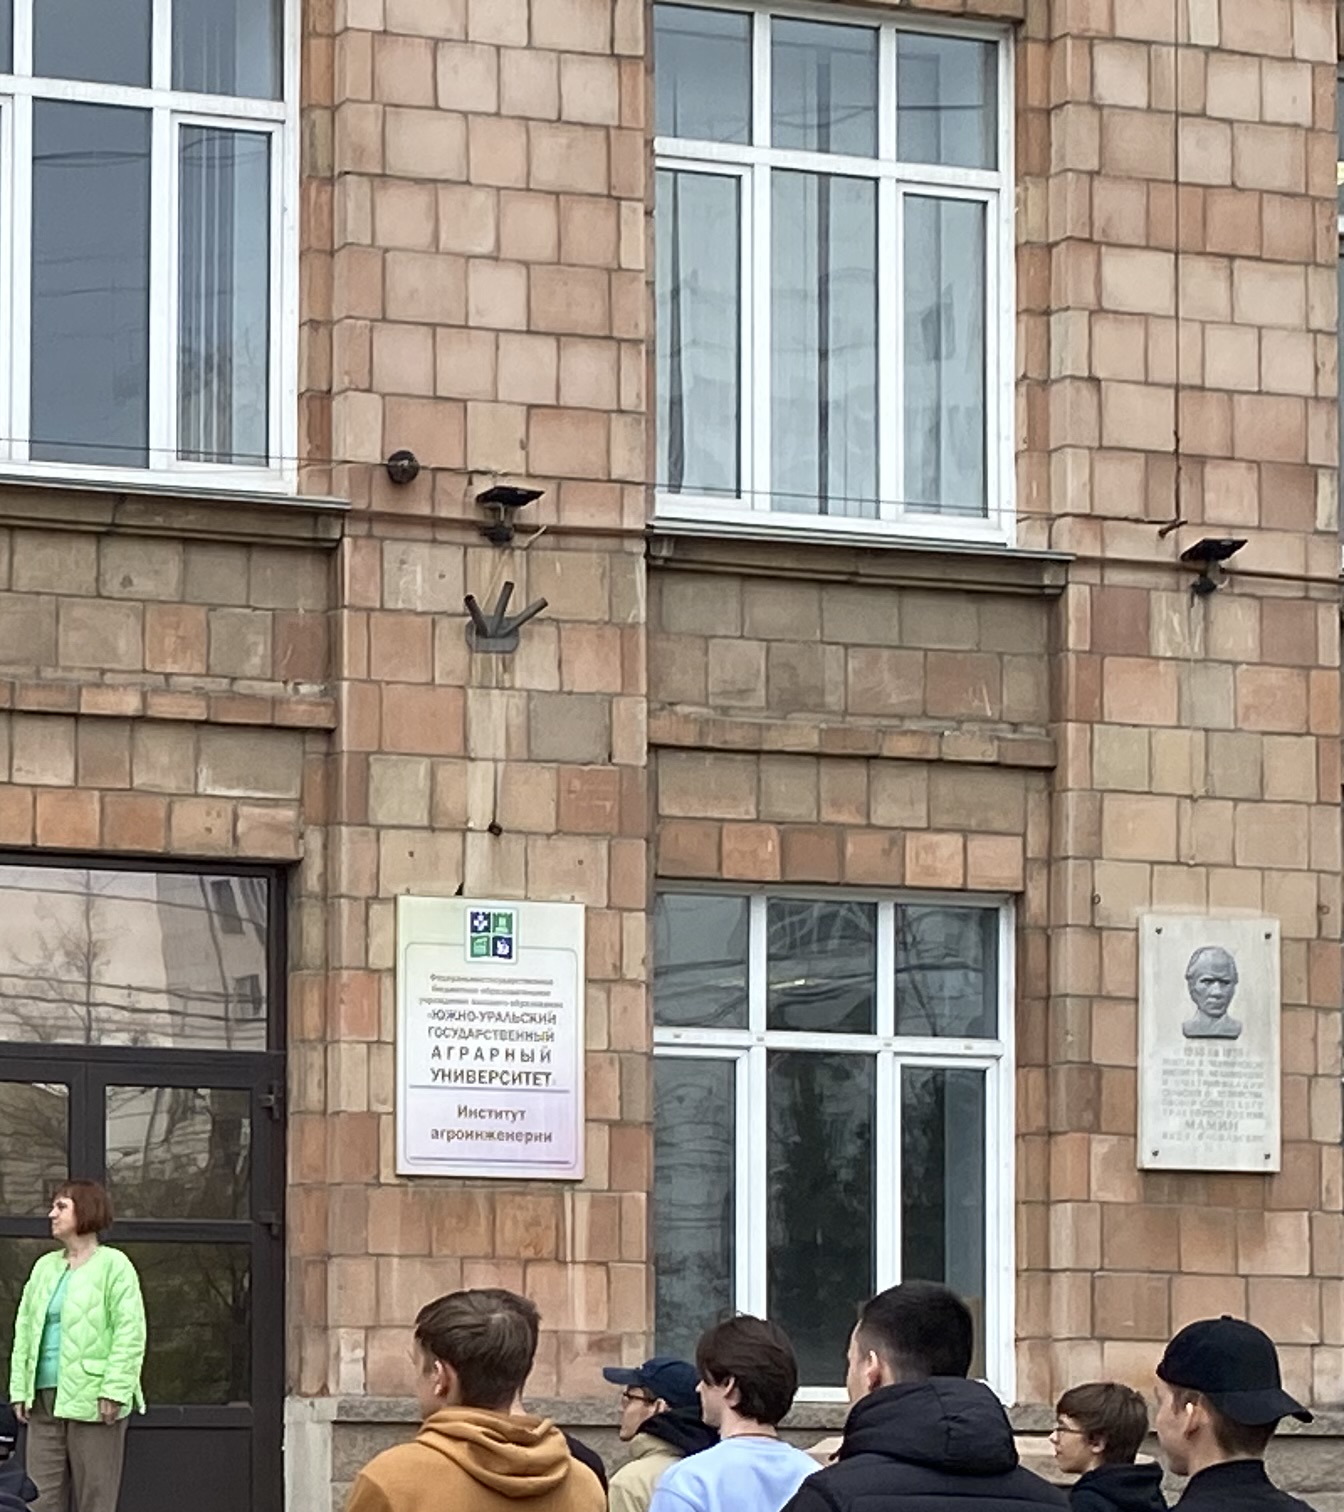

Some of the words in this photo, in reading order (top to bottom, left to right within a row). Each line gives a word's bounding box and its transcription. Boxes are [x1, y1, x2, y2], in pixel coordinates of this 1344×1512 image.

[427, 1025, 555, 1043] ГОСУДАРСТВЕННЫЙ
[430, 1044, 552, 1064] АГРАРНЫЙ
[456, 1104, 527, 1122] Институт
[430, 1127, 553, 1145] агроинженерии
